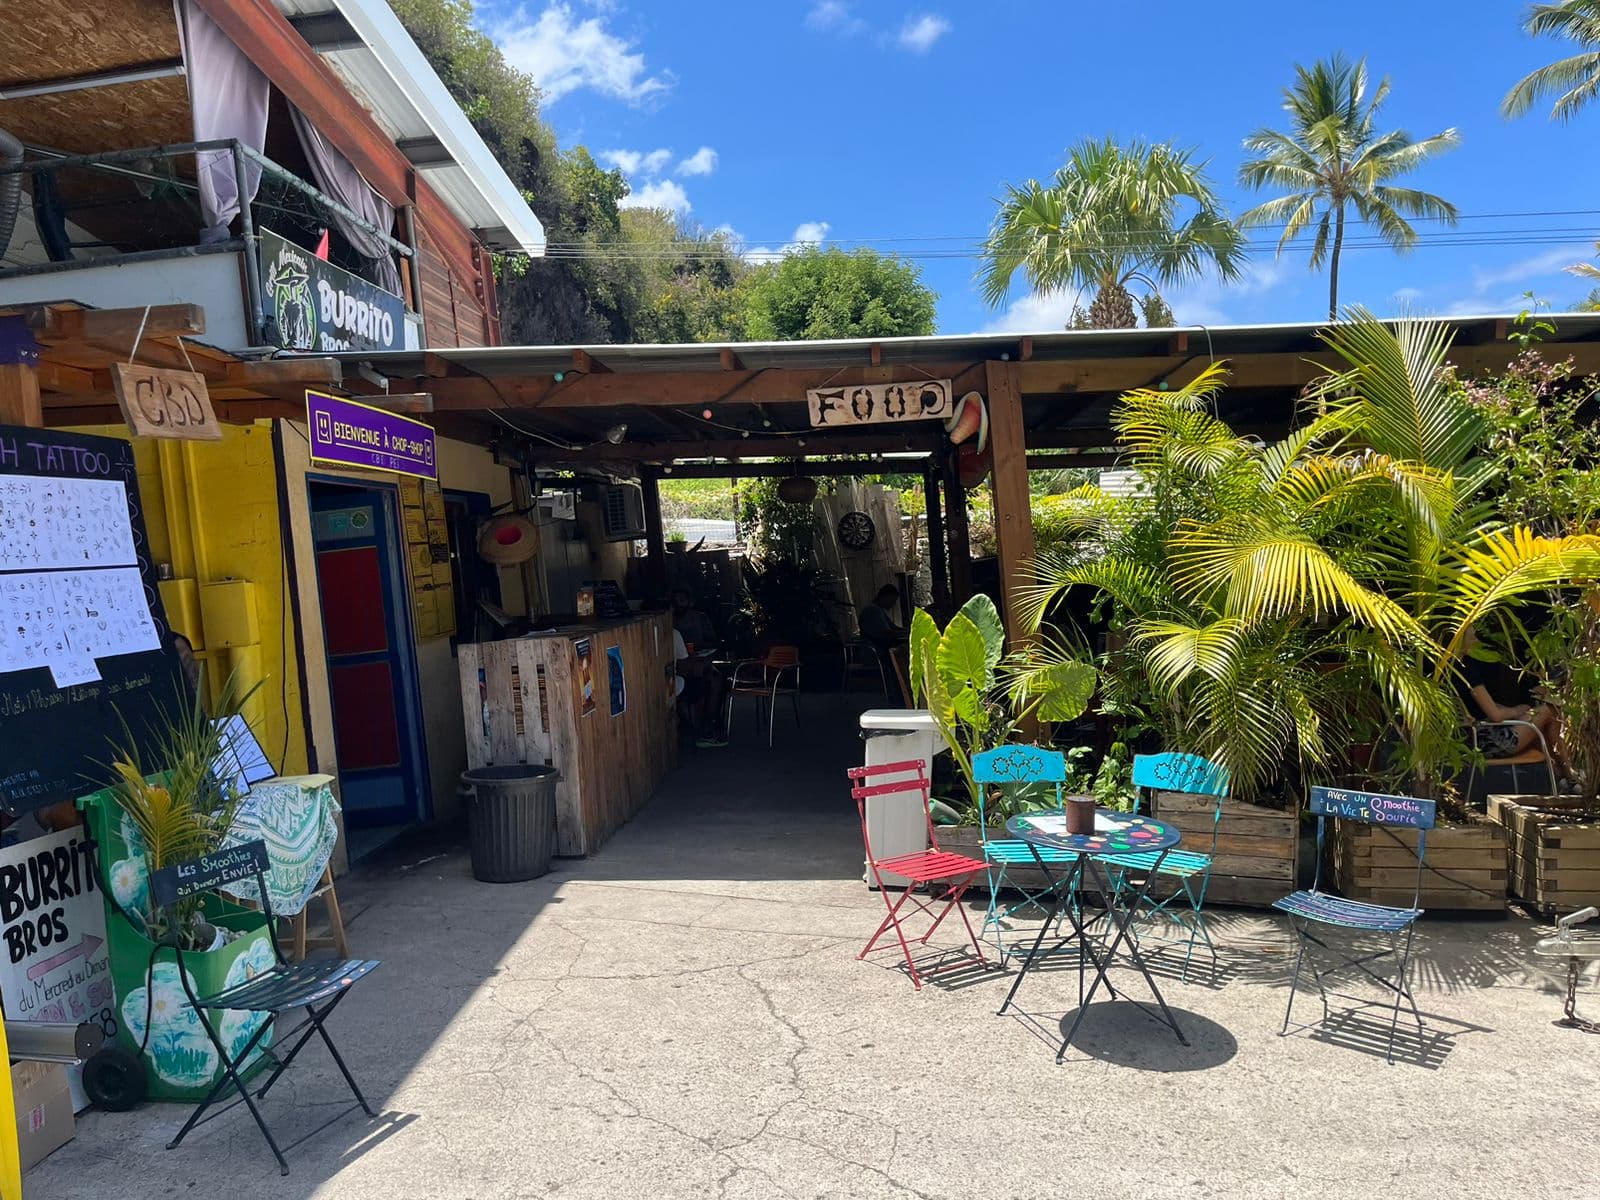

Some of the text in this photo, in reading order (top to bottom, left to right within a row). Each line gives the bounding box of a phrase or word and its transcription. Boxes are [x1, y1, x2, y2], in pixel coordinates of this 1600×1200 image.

[135, 375, 205, 428] CBD
[816, 381, 946, 425] FOOD
[334, 421, 424, 456] BIENVENUE À CHOP-SHOP
[26, 442, 111, 475] TATTOO
[1327, 790, 1348, 801] AVEC
[1353, 795, 1367, 803] UN
[0, 838, 99, 925] BURRiT
[3, 907, 69, 964] BROS
[19, 987, 34, 1012] du
